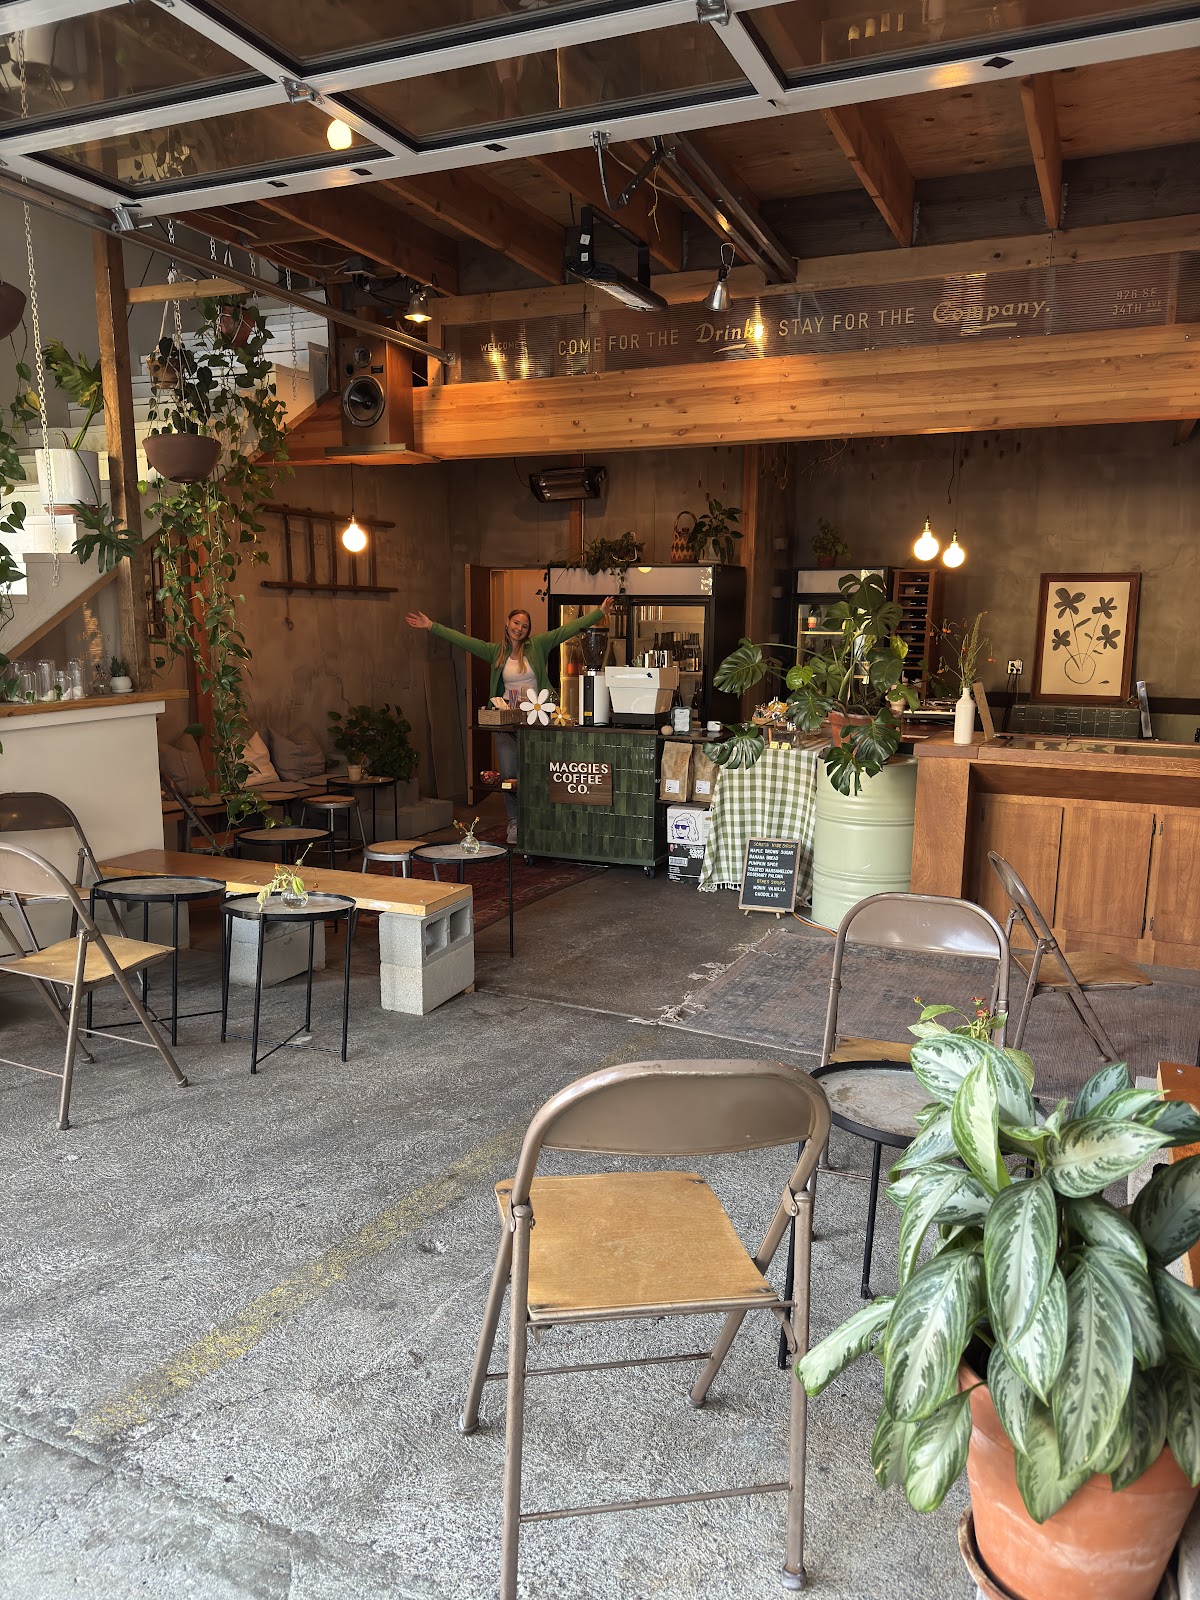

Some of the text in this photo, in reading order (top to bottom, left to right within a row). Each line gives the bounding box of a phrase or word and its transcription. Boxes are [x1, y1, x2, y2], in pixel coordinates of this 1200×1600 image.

[1116, 287, 1157, 300] 926 SE
[1112, 303, 1142, 315] 34TH
[558, 337, 602, 356] COME
[608, 333, 640, 351] FOR
[646, 329, 679, 347] THE
[778, 316, 824, 336] STAY
[832, 312, 869, 332] FOR
[877, 307, 915, 327] THE
[480, 341, 519, 352] WELCOME
[549, 761, 609, 774] MAGGIES
[553, 772, 603, 785] COFFEE
[567, 783, 590, 794] CO.
